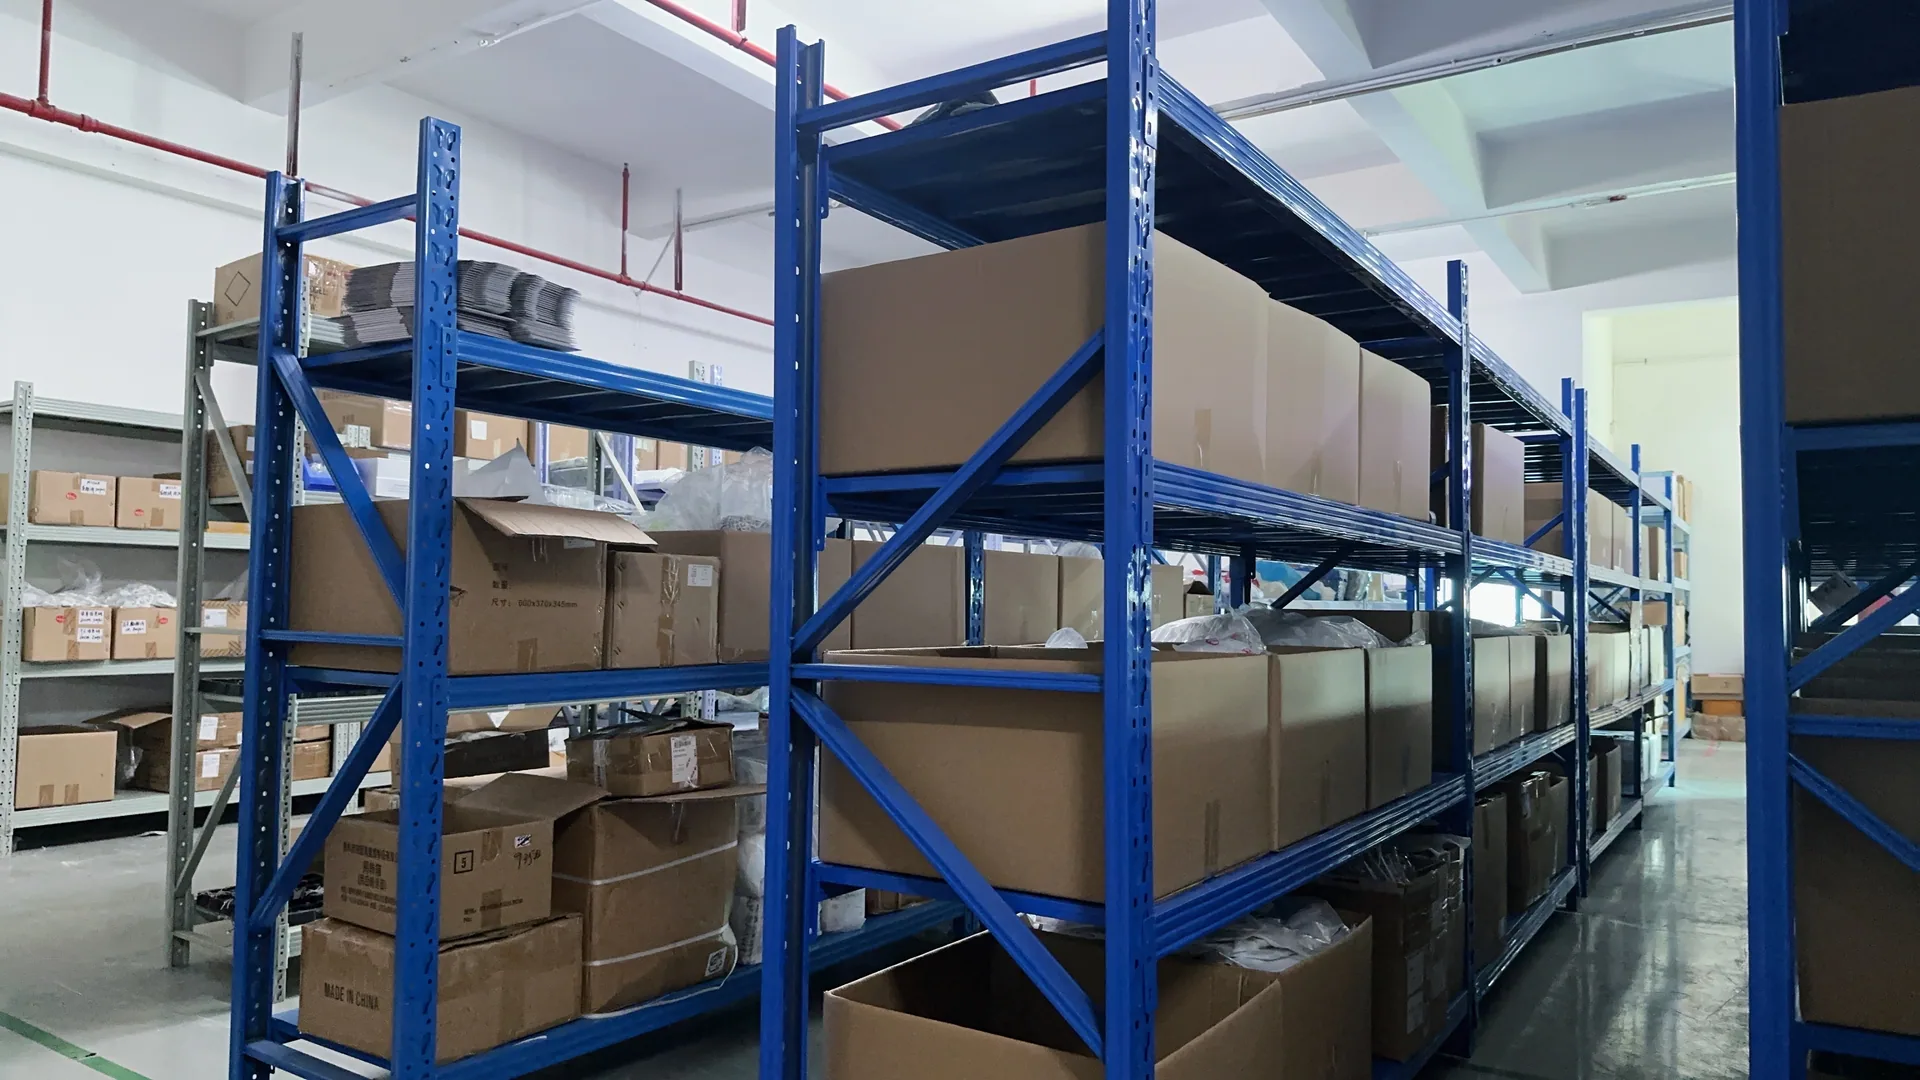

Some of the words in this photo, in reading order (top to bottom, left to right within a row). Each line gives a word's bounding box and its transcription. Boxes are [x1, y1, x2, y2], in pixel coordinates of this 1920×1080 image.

[461, 857, 467, 869] 5
[324, 982, 345, 1002] MADE
[346, 989, 354, 1004] IN
[355, 991, 380, 1011] CHINA
